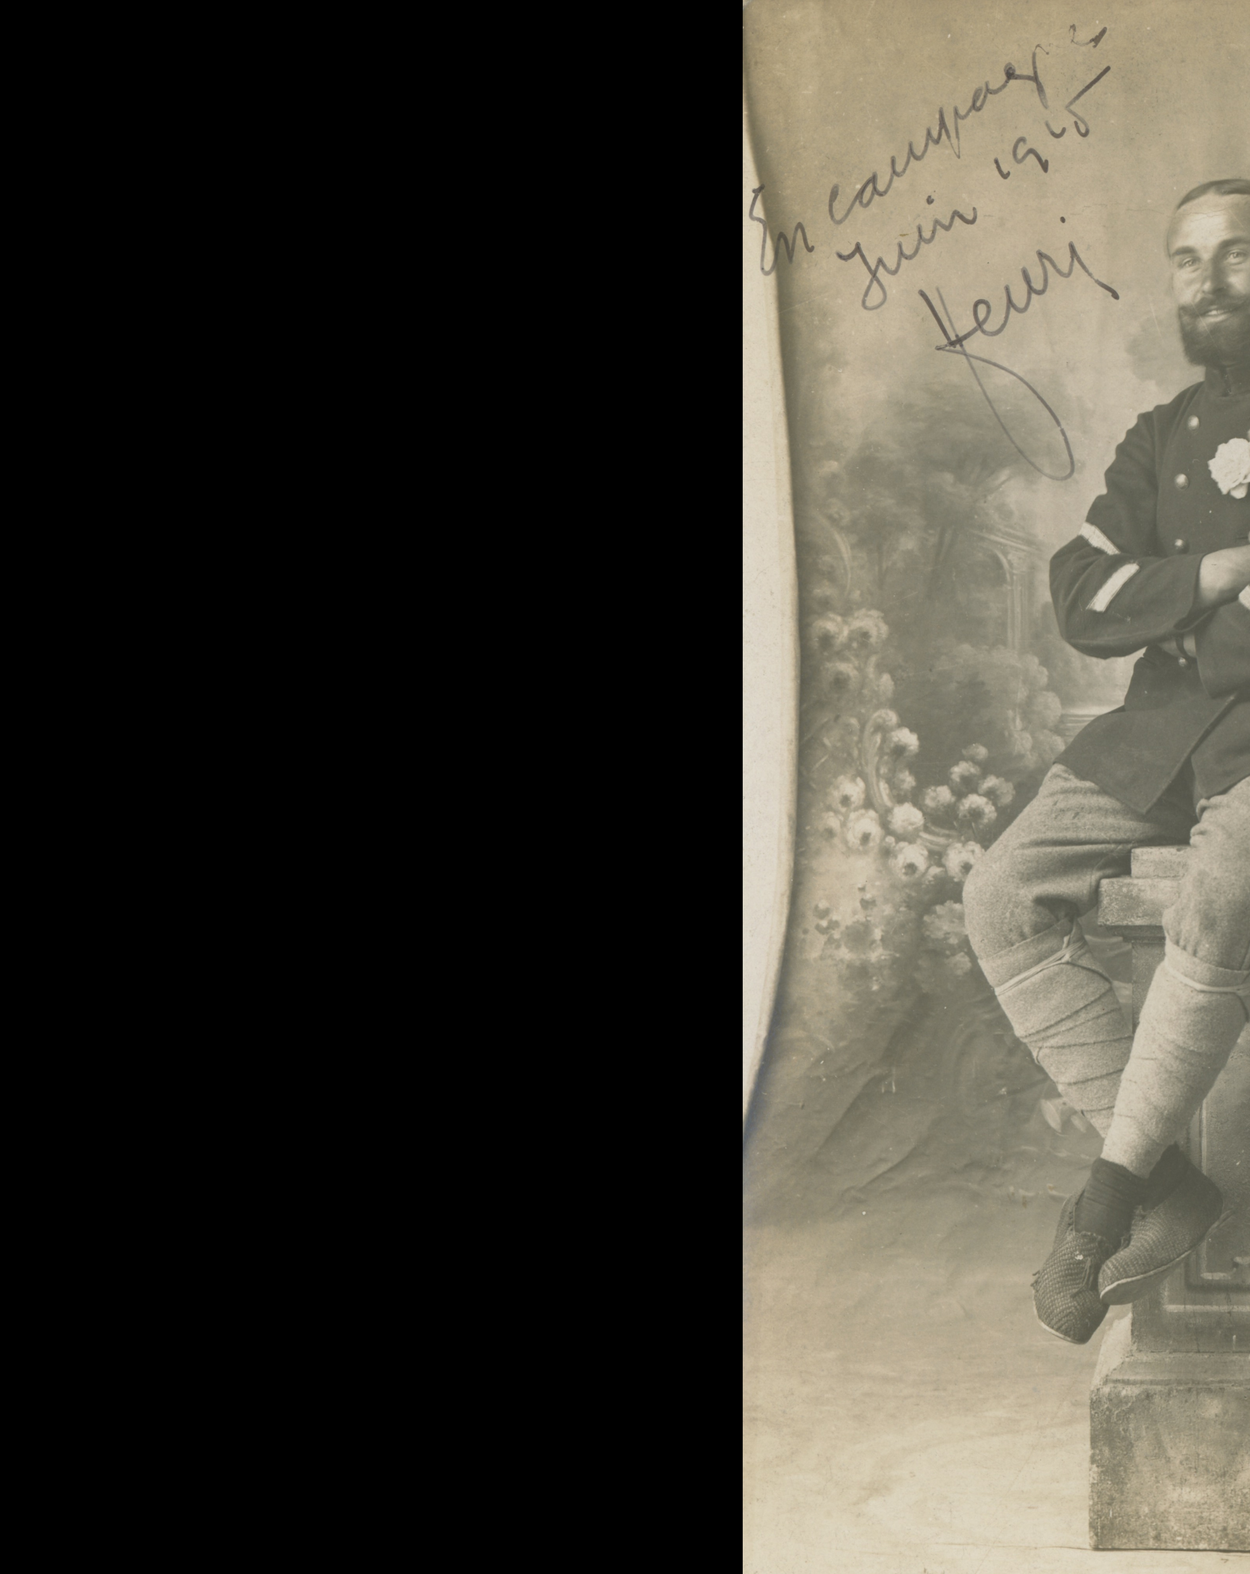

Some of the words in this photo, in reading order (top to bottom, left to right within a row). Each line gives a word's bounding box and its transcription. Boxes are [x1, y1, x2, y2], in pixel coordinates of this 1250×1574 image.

[993, 65, 1112, 180] 1915
[750, 183, 815, 276] En
[918, 216, 1120, 481] Henri
